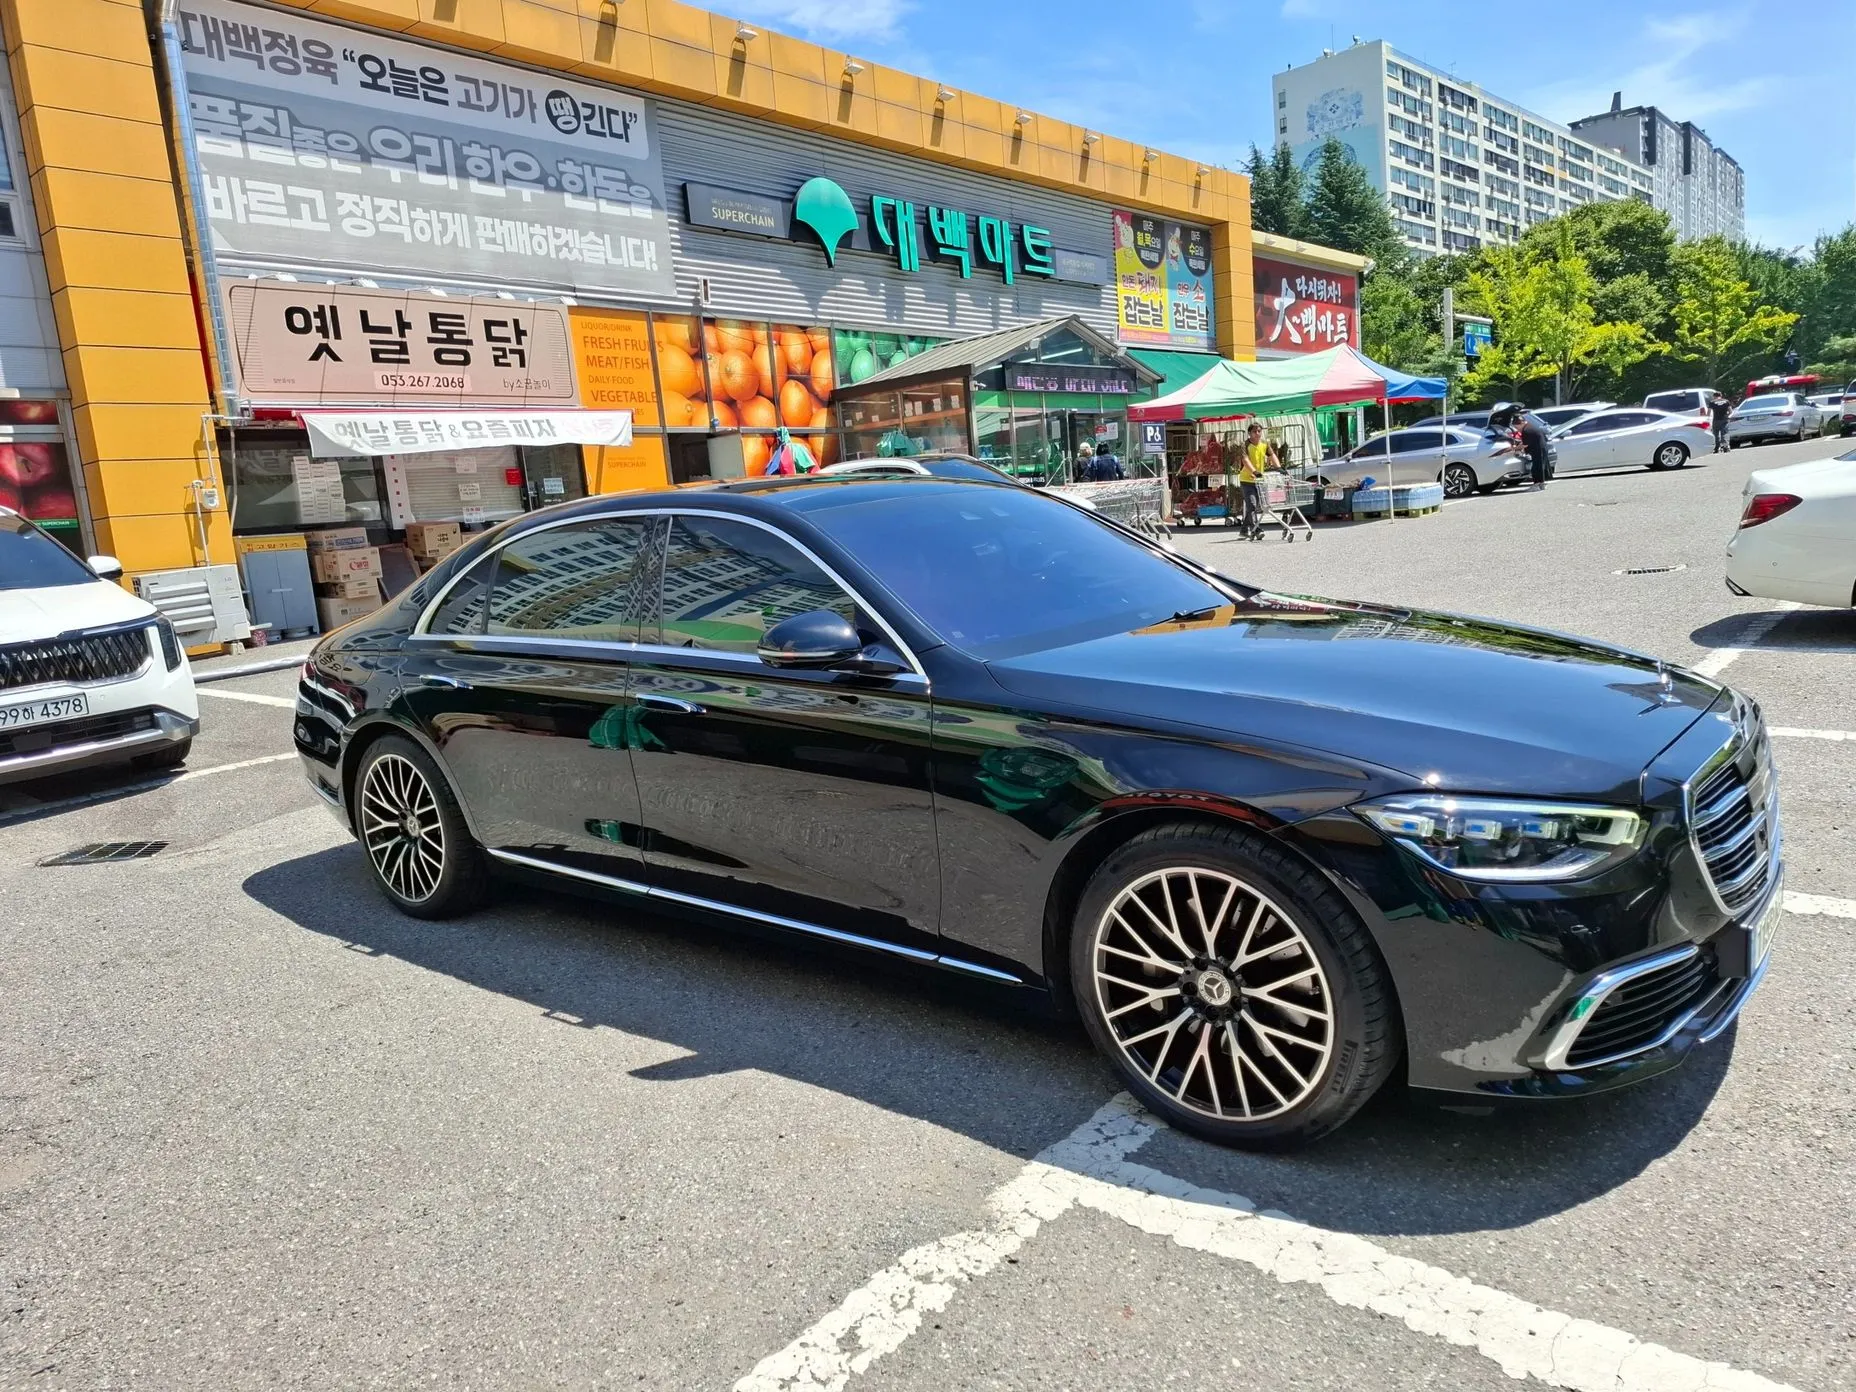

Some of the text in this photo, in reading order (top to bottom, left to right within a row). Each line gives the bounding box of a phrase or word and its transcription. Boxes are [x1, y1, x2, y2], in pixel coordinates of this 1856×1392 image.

[180, 10, 338, 85] 대백정육
[455, 74, 537, 124] 고기가
[369, 125, 458, 191] 우리
[203, 174, 659, 271] 바르고 정직하게 판매하겠습니다!
[711, 206, 775, 228] SUPERCHAIN
[872, 194, 1056, 285] 대백마트
[1124, 295, 1164, 328] 잡는날
[1173, 302, 1209, 332] 잡는날
[284, 304, 528, 368] 옛날통닭
[580, 321, 633, 332] LIQUOR/DRINK
[583, 335, 621, 350] FRESH
[586, 355, 650, 370] MEAT/FISH
[381, 374, 465, 389] 053.267.2068
[448, 423, 461, 438] &
[461, 418, 557, 440] 요즘피자
[1146, 426, 1155, 442] P
[41, 698, 83, 718] 4378
